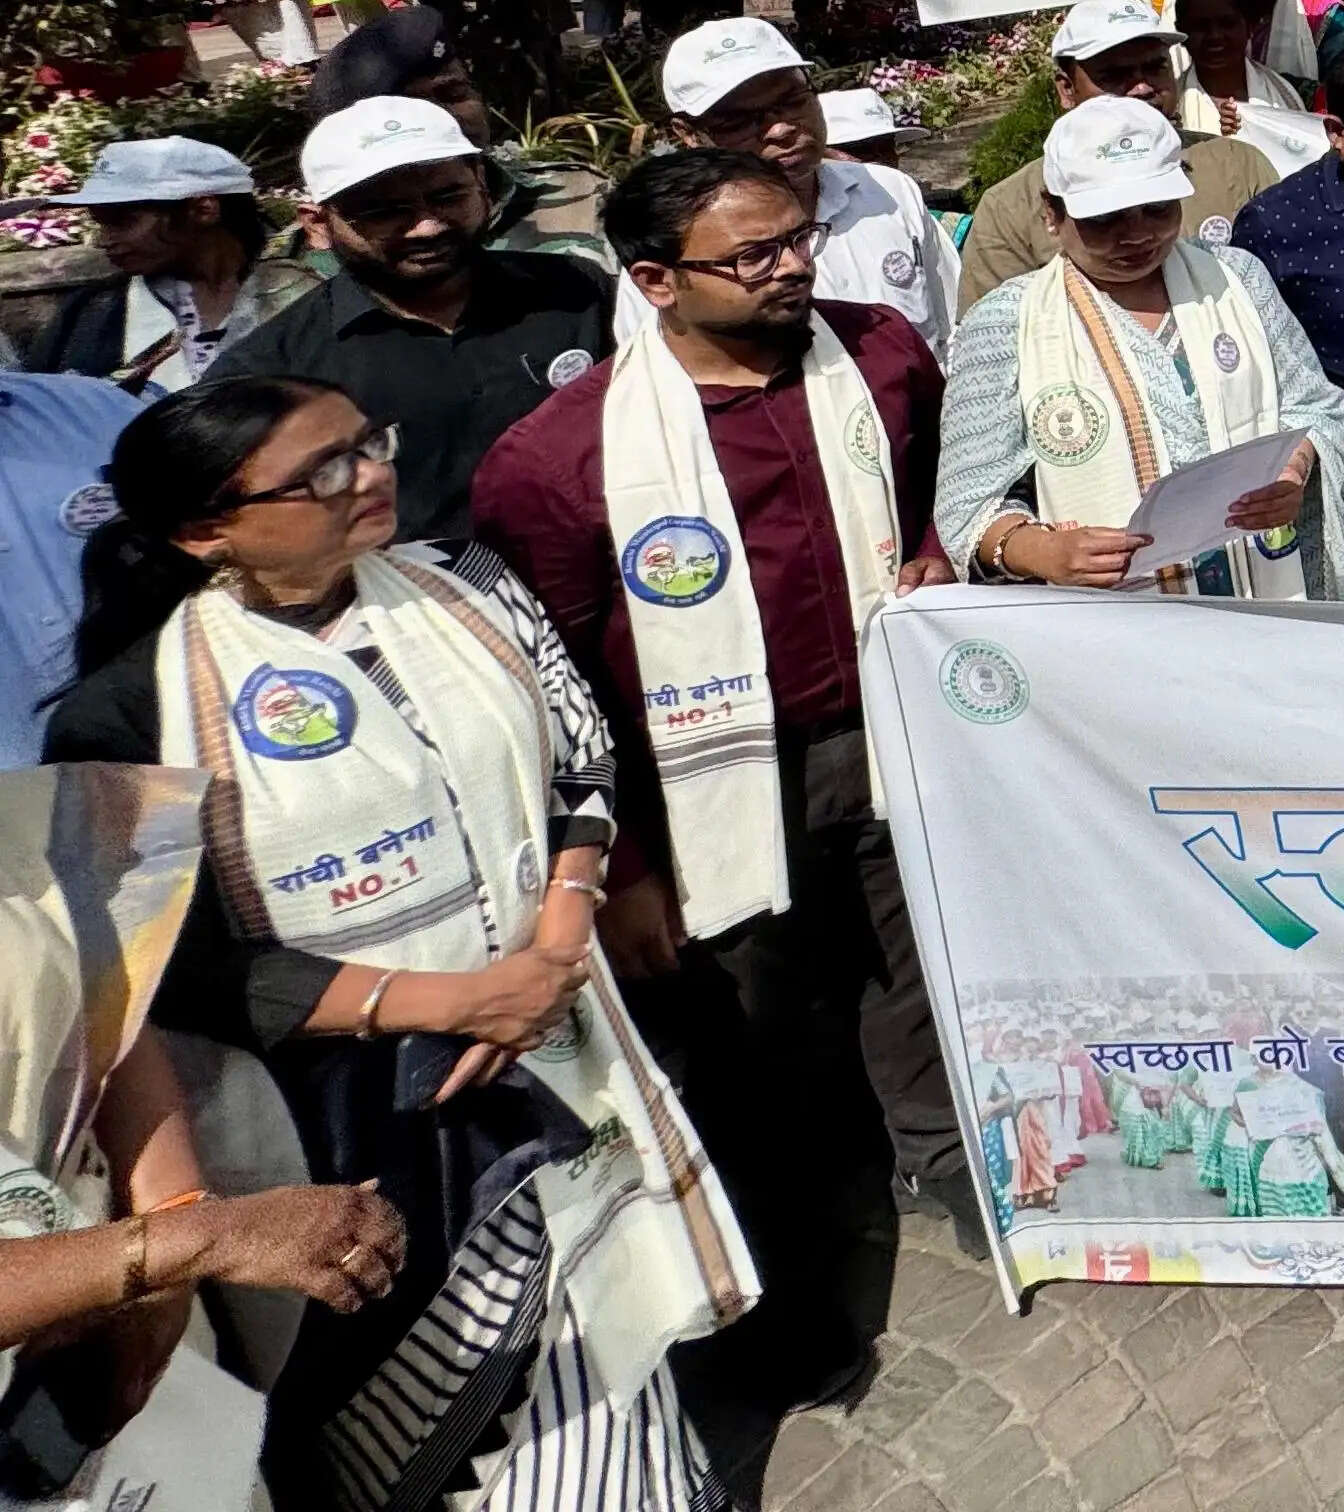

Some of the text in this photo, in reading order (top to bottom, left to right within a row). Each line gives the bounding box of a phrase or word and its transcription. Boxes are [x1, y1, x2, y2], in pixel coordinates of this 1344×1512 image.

[666, 700, 733, 729] NO.1
[268, 852, 347, 894] रांची
[328, 855, 420, 908] NO.1
[1085, 1039, 1234, 1078] स्वच्छता
[1253, 1027, 1311, 1072] को
